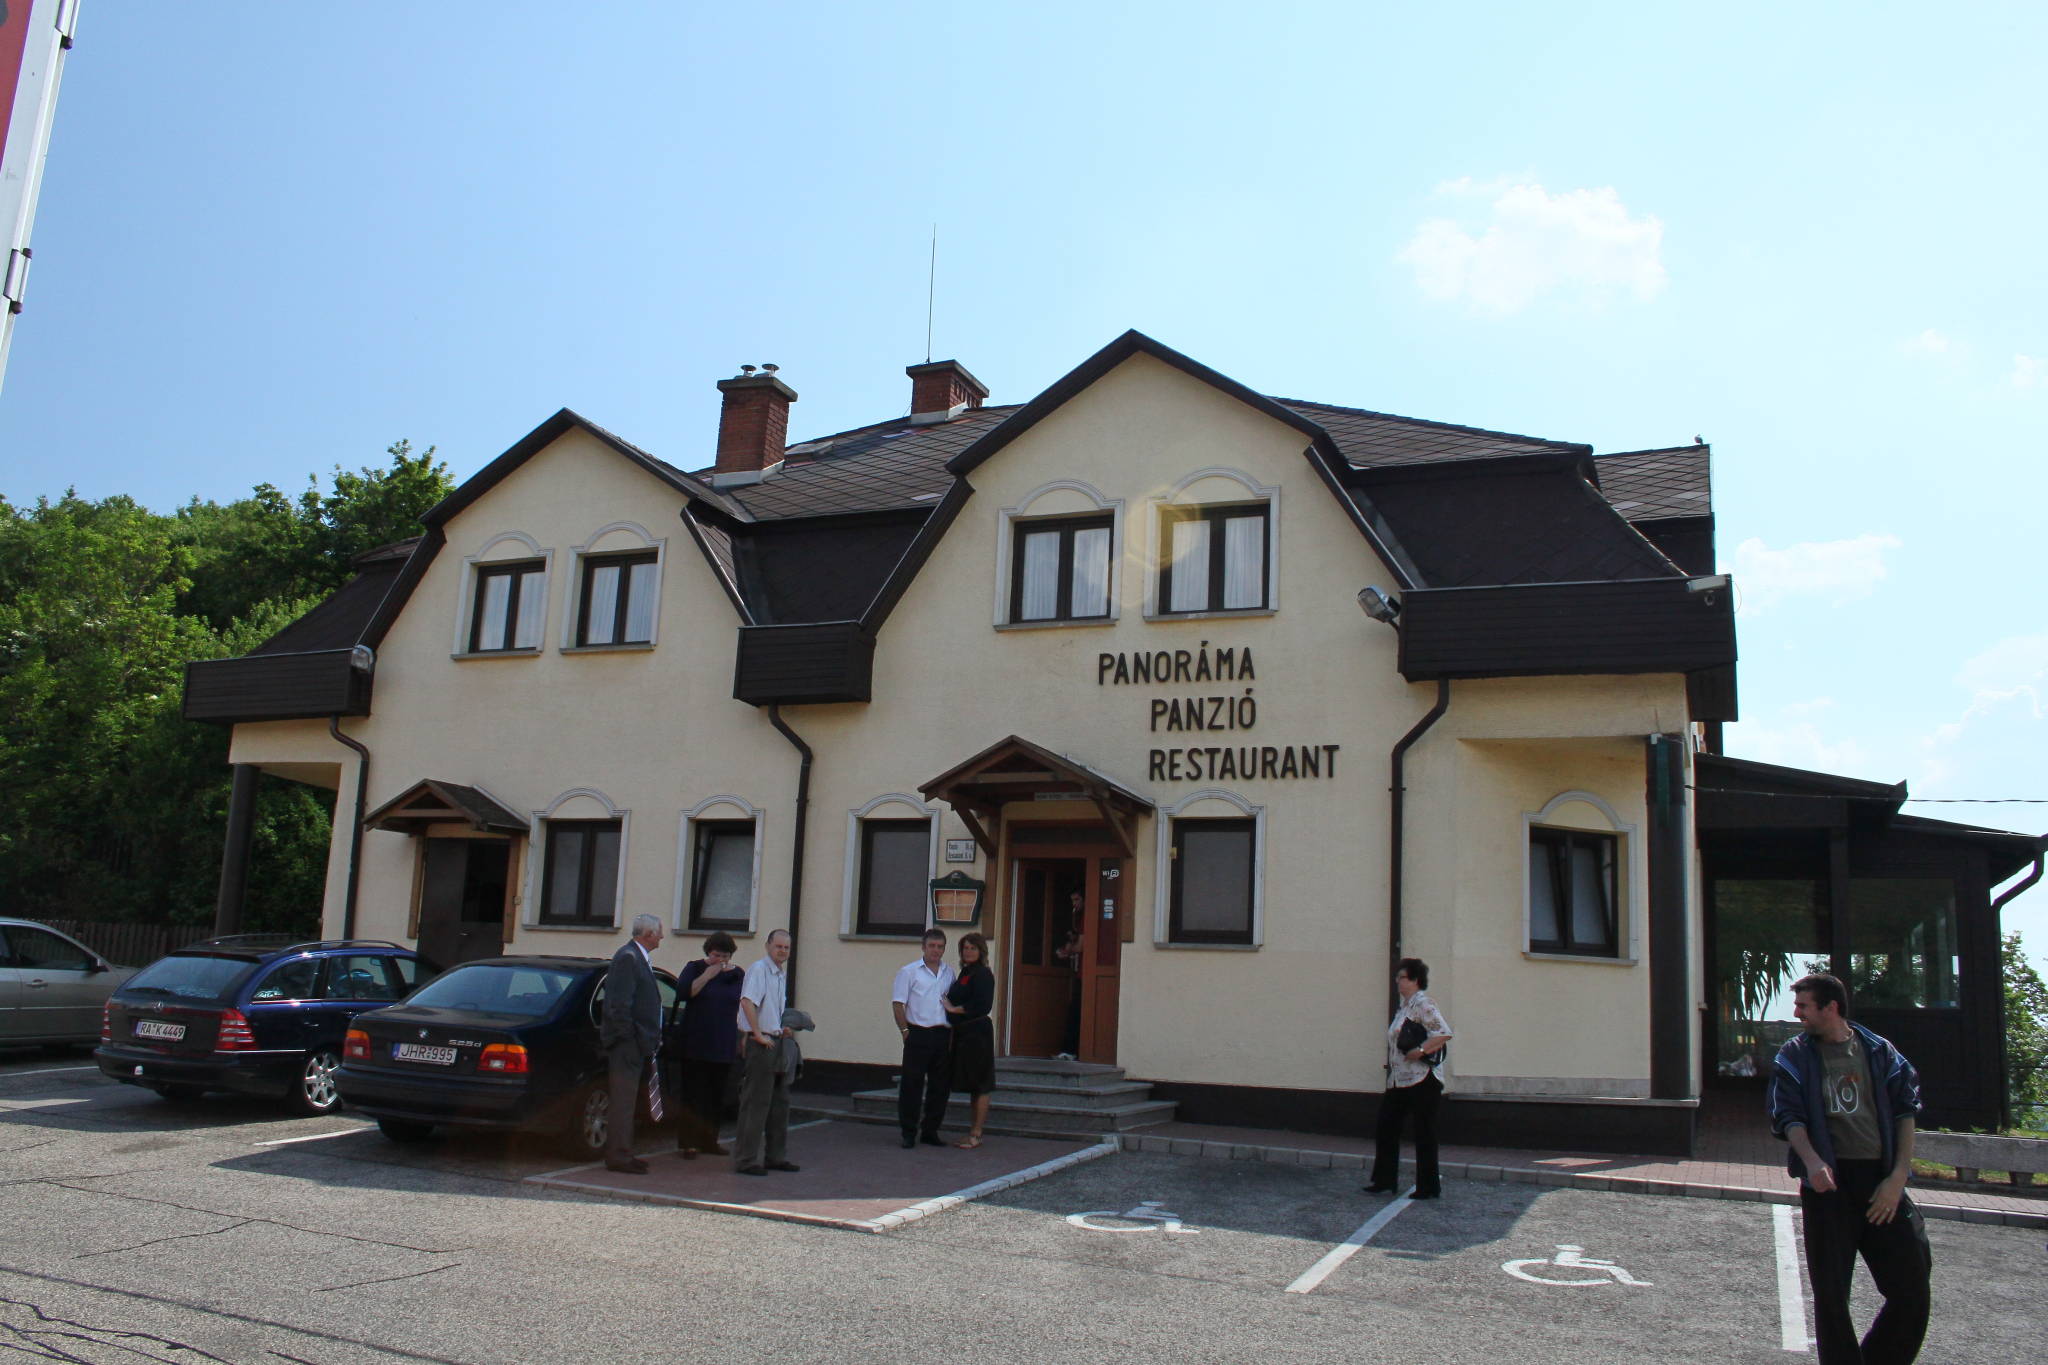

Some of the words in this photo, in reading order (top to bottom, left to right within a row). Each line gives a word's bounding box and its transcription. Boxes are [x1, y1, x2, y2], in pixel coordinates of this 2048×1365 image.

[1098, 641, 1255, 686] PANORÁMA
[1150, 688, 1256, 732] PANZIÓ
[1149, 745, 1340, 781] RESTAURANT
